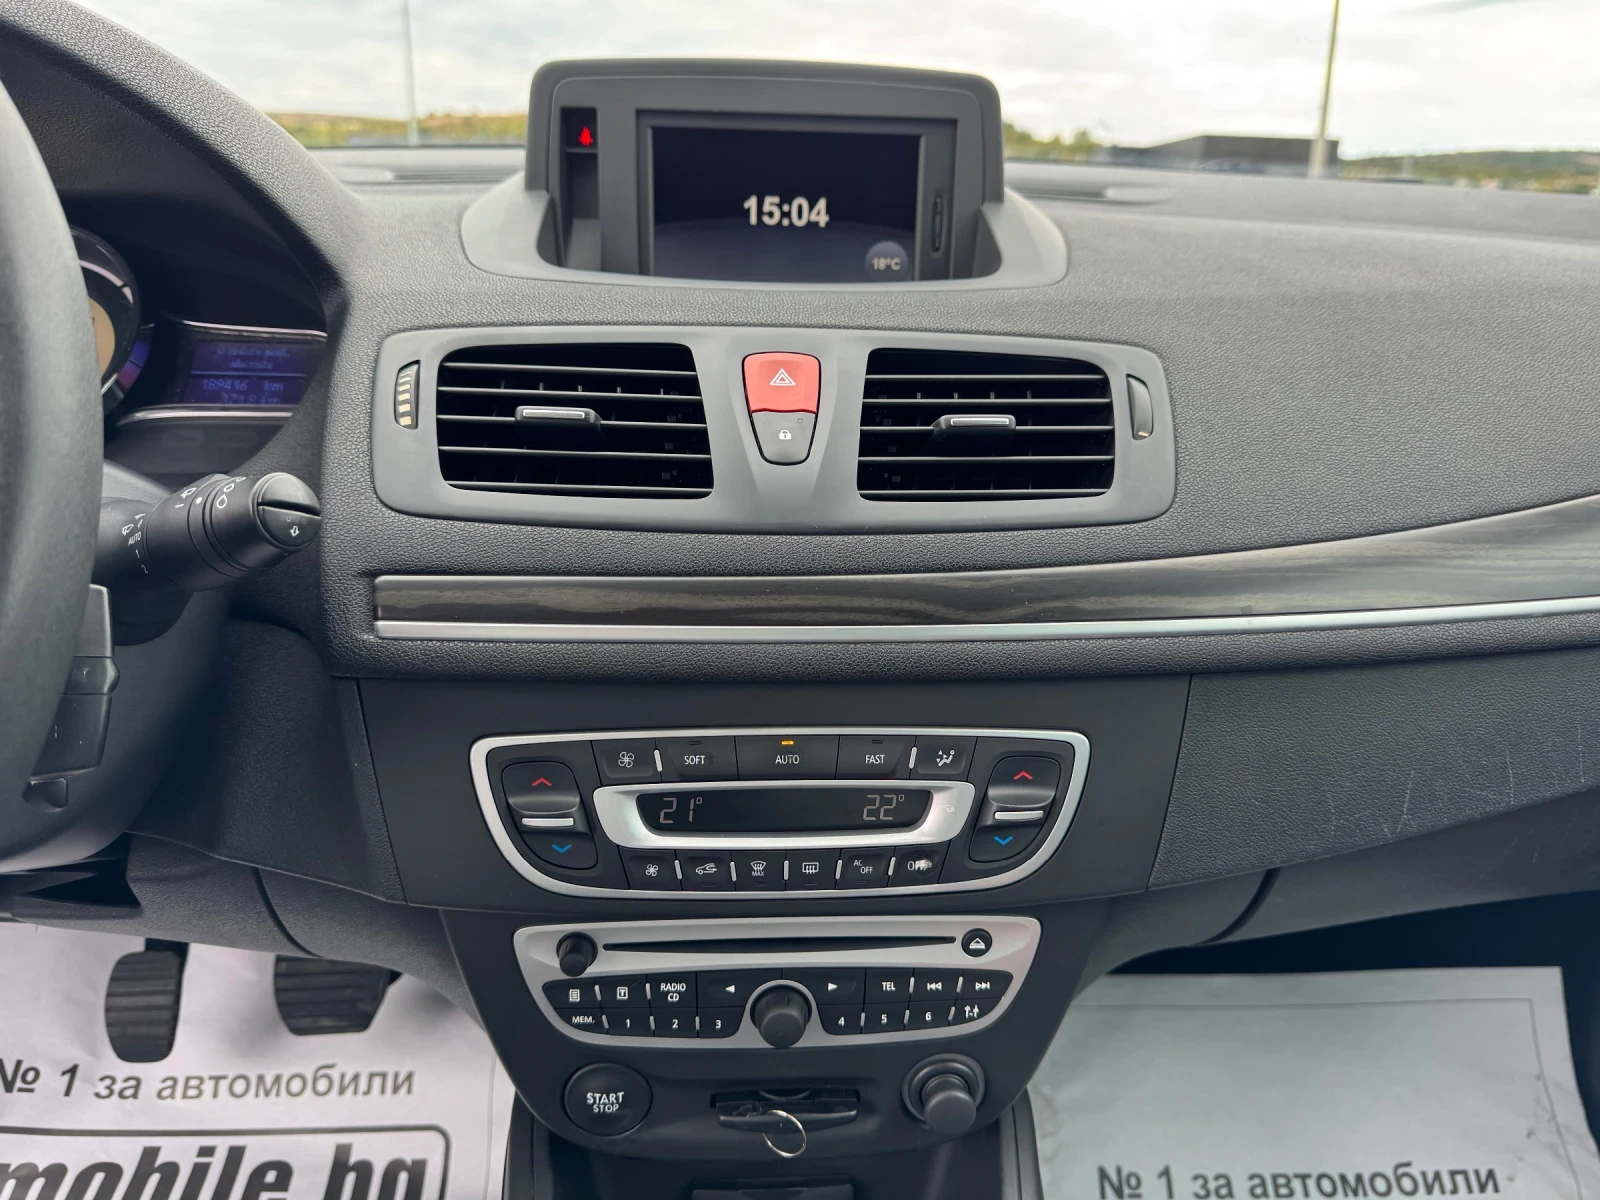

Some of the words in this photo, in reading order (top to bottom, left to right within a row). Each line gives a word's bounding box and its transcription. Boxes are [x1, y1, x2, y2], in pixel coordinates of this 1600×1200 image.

[743, 194, 829, 227] 15:04
[872, 257, 901, 270] 18°C
[263, 381, 283, 392] km
[128, 531, 142, 546] AUTO
[684, 755, 705, 765] SOFT
[775, 754, 800, 765] AUTO
[865, 754, 885, 764] FAST
[853, 859, 862, 867] AC
[860, 866, 873, 874] OFF
[660, 982, 686, 992] RADIO
[882, 981, 896, 991] TEL
[667, 993, 679, 1002] CD
[572, 1015, 595, 1024] MEM.
[838, 1016, 845, 1027] 4
[881, 1014, 887, 1024] 5
[925, 1011, 932, 1022] 6
[625, 1018, 631, 1028] 1
[672, 1019, 678, 1028] 2
[715, 1019, 722, 1029] 3
[60, 1063, 79, 1097] 1
[94, 1074, 142, 1100] за
[156, 1063, 416, 1101] автомобили
[586, 1092, 624, 1105] START
[593, 1103, 619, 1113] STOP
[1157, 1164, 1174, 1200] 1
[1192, 1172, 1234, 1200] за
[1246, 1161, 1500, 1199] автомобили
